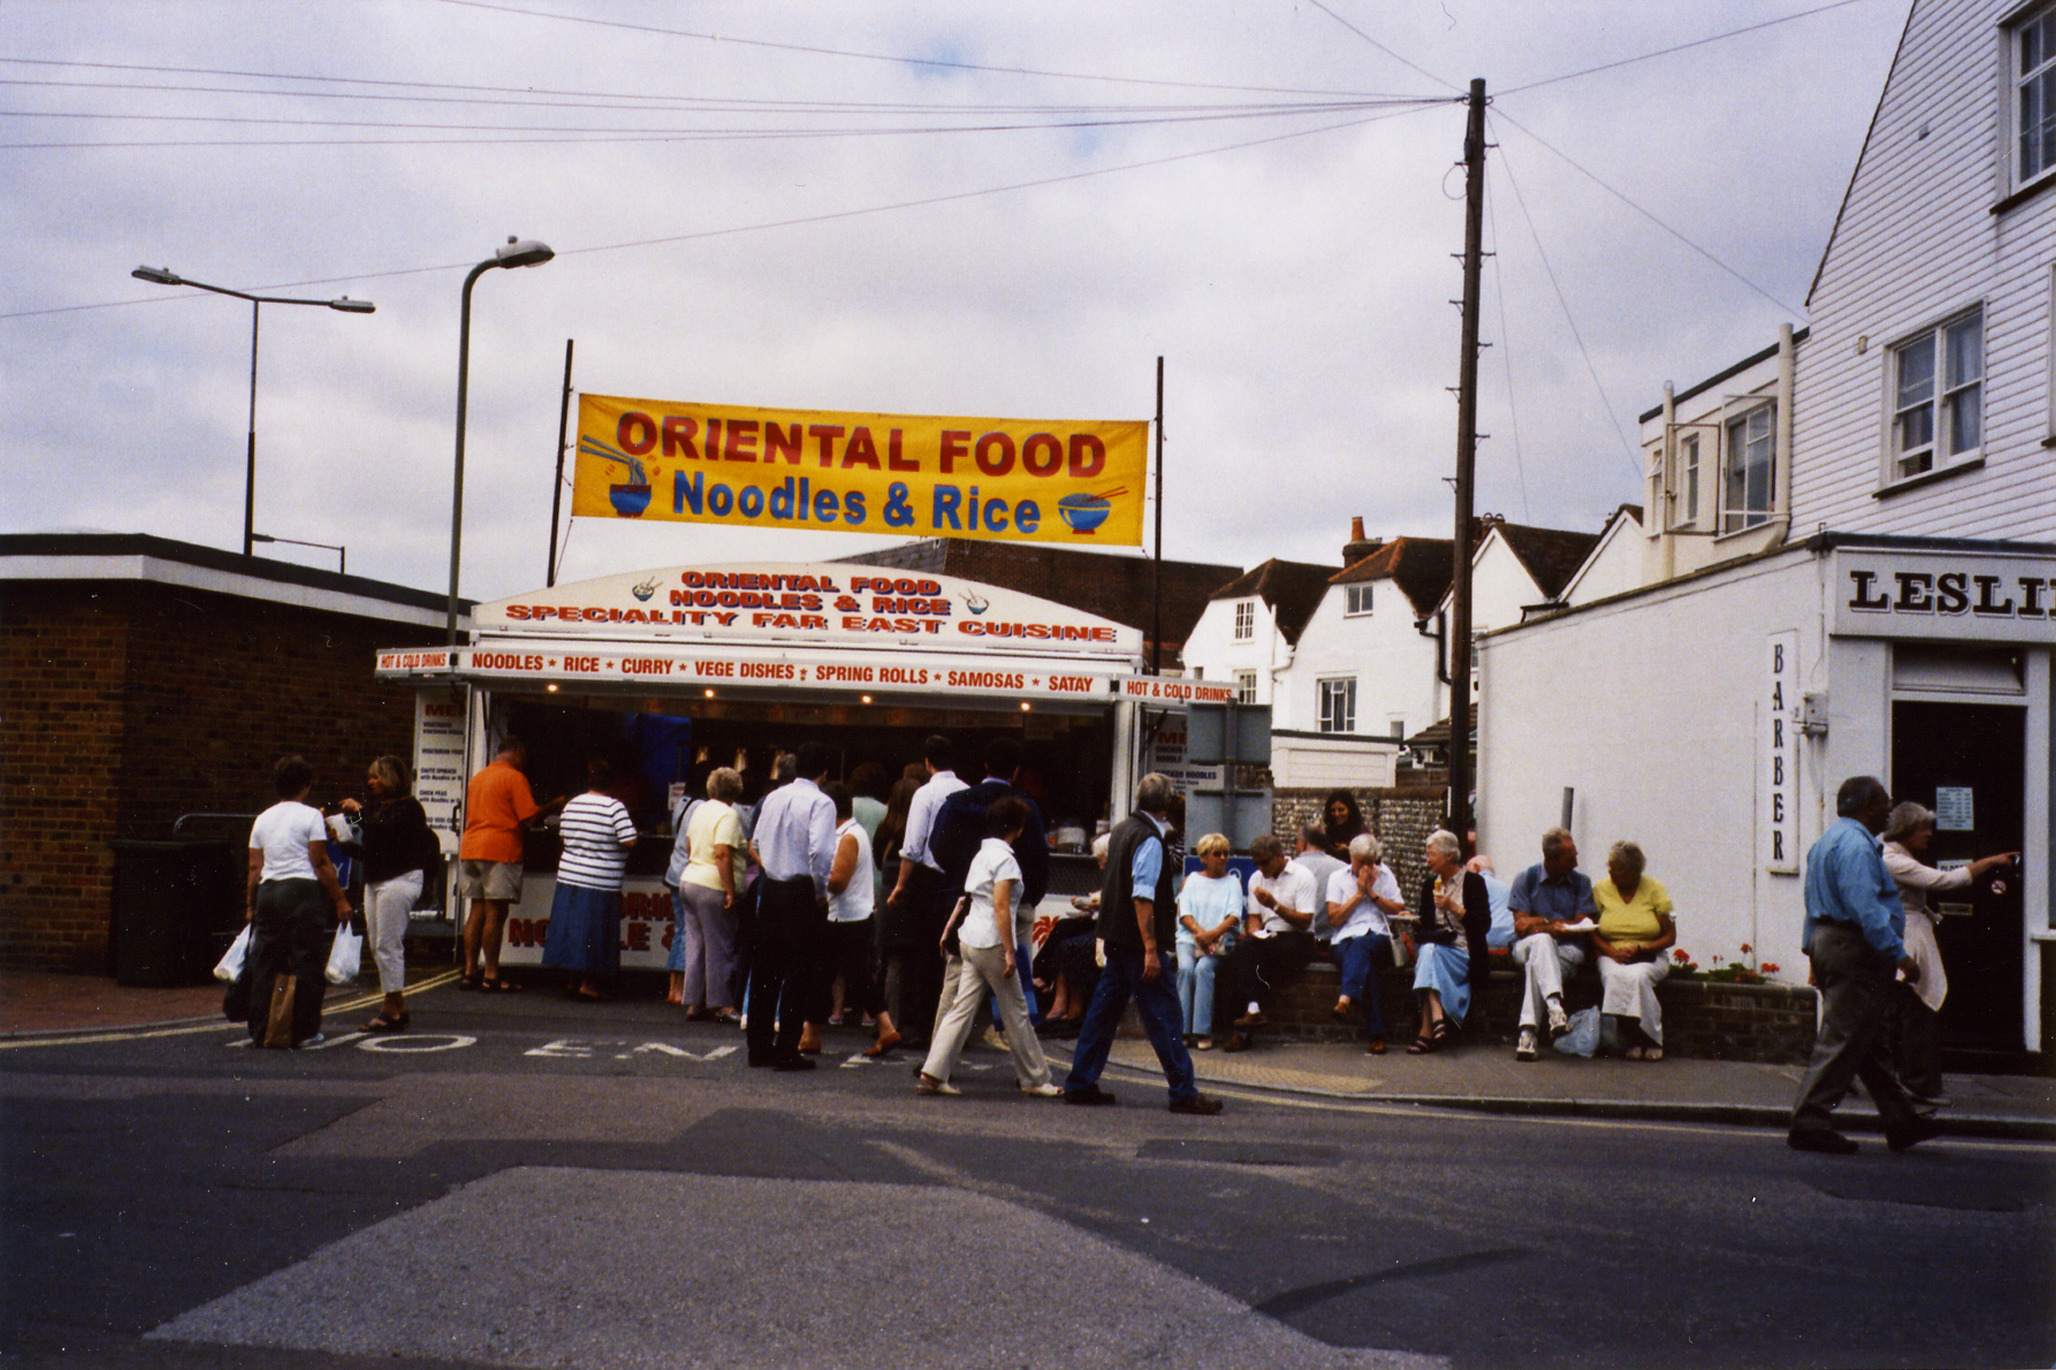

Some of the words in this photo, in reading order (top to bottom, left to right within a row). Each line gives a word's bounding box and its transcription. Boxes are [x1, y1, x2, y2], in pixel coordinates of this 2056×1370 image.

[616, 410, 920, 473] ORIENTAL
[939, 429, 1107, 477] FOOD
[672, 470, 867, 525] Noodles
[883, 481, 916, 528] &
[932, 484, 1041, 534] Rice
[669, 589, 824, 611] NOODLES
[833, 595, 861, 613] &
[872, 596, 952, 616] RICE
[681, 571, 840, 593] ORIENTAL
[850, 576, 941, 596] FOOD
[1848, 570, 2056, 621] LESLI
[505, 604, 739, 627] SPECIALITY
[752, 612, 828, 631] FAR
[842, 615, 946, 634] EAST
[957, 620, 1118, 643] CUISINE
[381, 653, 394, 669] HOT
[395, 653, 401, 669] &
[402, 653, 420, 668] COLD
[421, 652, 446, 668] DRINKS
[472, 652, 543, 671] NOODLES
[563, 655, 600, 673] RICE
[621, 658, 674, 675] CURRY
[695, 661, 735, 678] VEGE
[740, 662, 795, 680] DISHES
[816, 665, 874, 682] SPRING
[879, 667, 928, 685] ROLLS
[948, 671, 1025, 690] SAMOSAS
[1048, 675, 1094, 692] SATAY
[1127, 680, 1149, 696] HOT
[1152, 682, 1160, 698] &
[1164, 683, 1192, 700] COLD
[1195, 686, 1233, 702] DRINKS
[1772, 643, 1784, 861] BARBER
